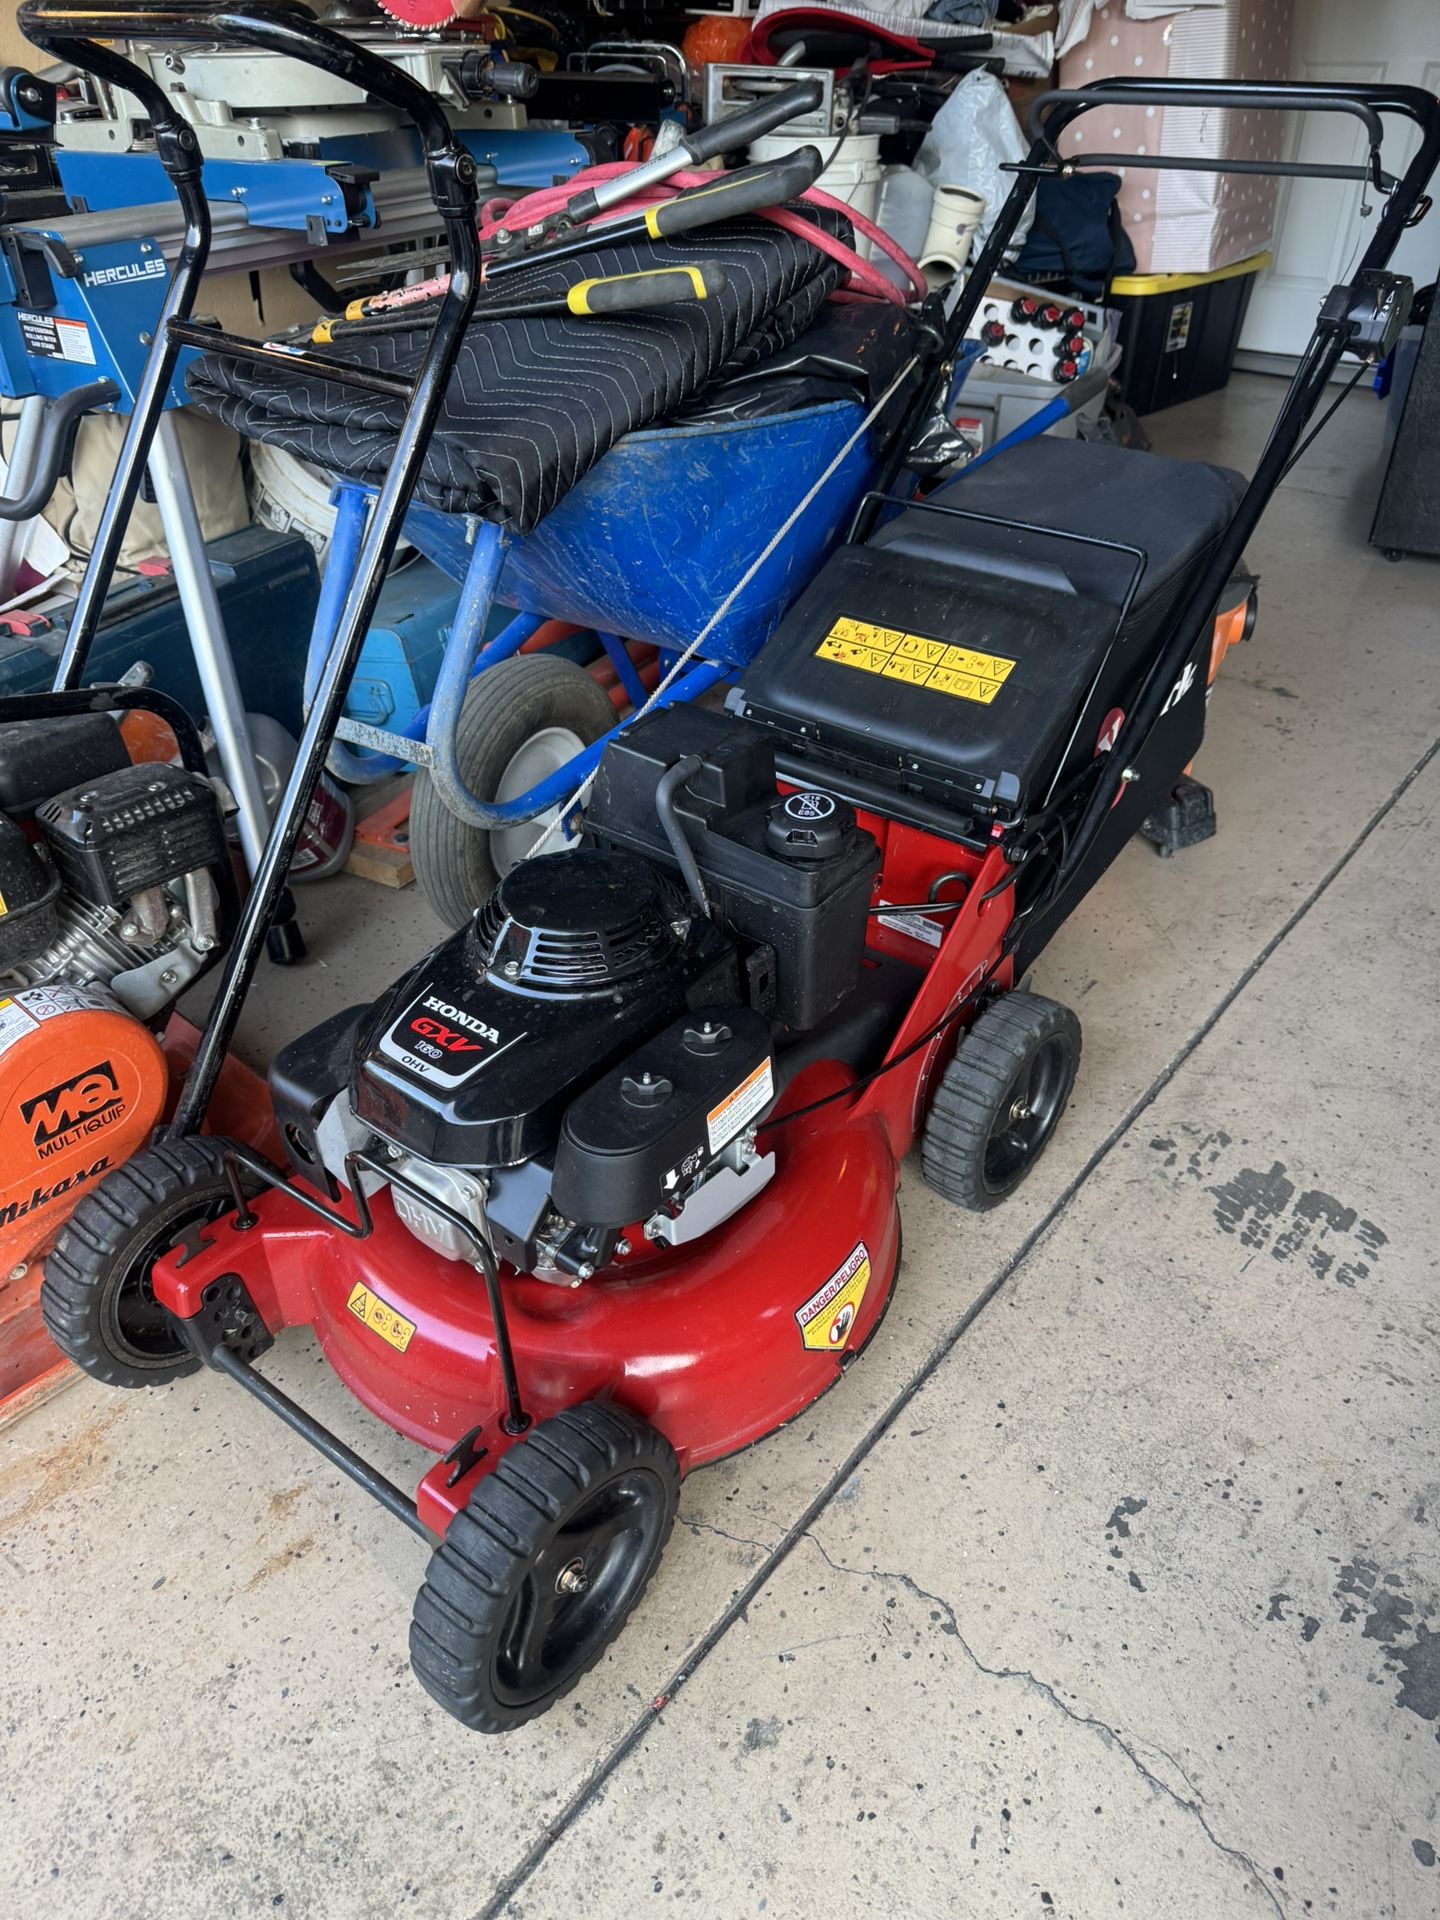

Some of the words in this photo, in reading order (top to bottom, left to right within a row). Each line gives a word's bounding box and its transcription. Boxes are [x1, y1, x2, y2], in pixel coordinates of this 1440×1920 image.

[83, 258, 166, 287] HERCULES
[17, 312, 54, 326] HERCULES
[411, 1016, 483, 1053] GXV
[422, 996, 499, 1044] HONDA
[402, 1055, 429, 1073] OHV
[414, 1040, 443, 1060] 160
[37, 1104, 125, 1160] MULTIQUIP
[0, 1155, 115, 1228] Mikasa
[800, 1248, 865, 1323] DANGER/PELIGRO
